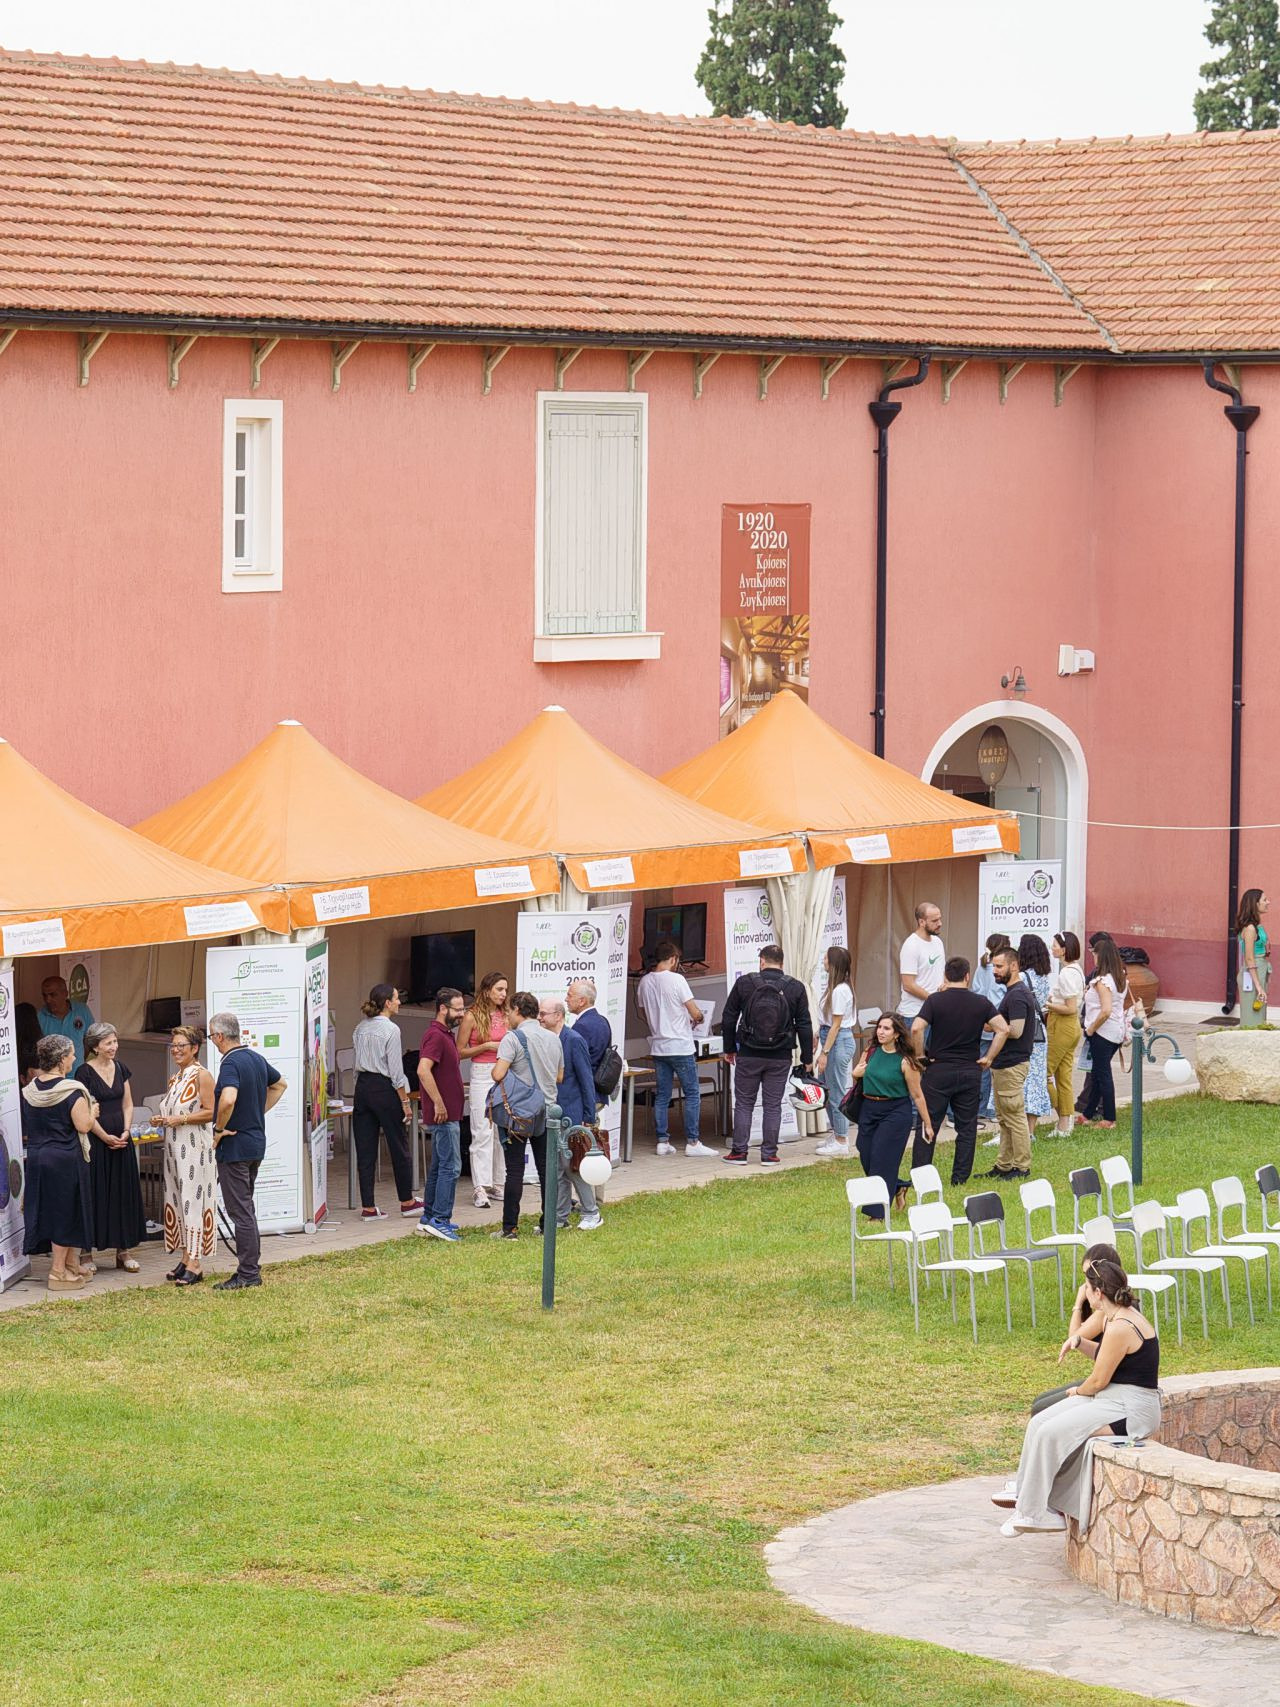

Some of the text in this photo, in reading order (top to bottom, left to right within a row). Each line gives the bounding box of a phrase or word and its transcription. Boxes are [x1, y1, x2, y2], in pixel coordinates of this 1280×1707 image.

[738, 512, 774, 531] 1920
[750, 530, 787, 549] 2020
[756, 554, 786, 574] Κρίσεις
[739, 572, 786, 592] ΑντιΚρίσεις
[740, 591, 786, 612] ΣυγΚρίσεις
[992, 892, 1014, 906] Agri
[991, 901, 1049, 915] Innovation
[734, 920, 749, 935] Agri
[1023, 918, 1049, 928] 2023
[734, 930, 774, 944] Innovation
[531, 946, 556, 962] Agri
[530, 958, 596, 972] Innovation
